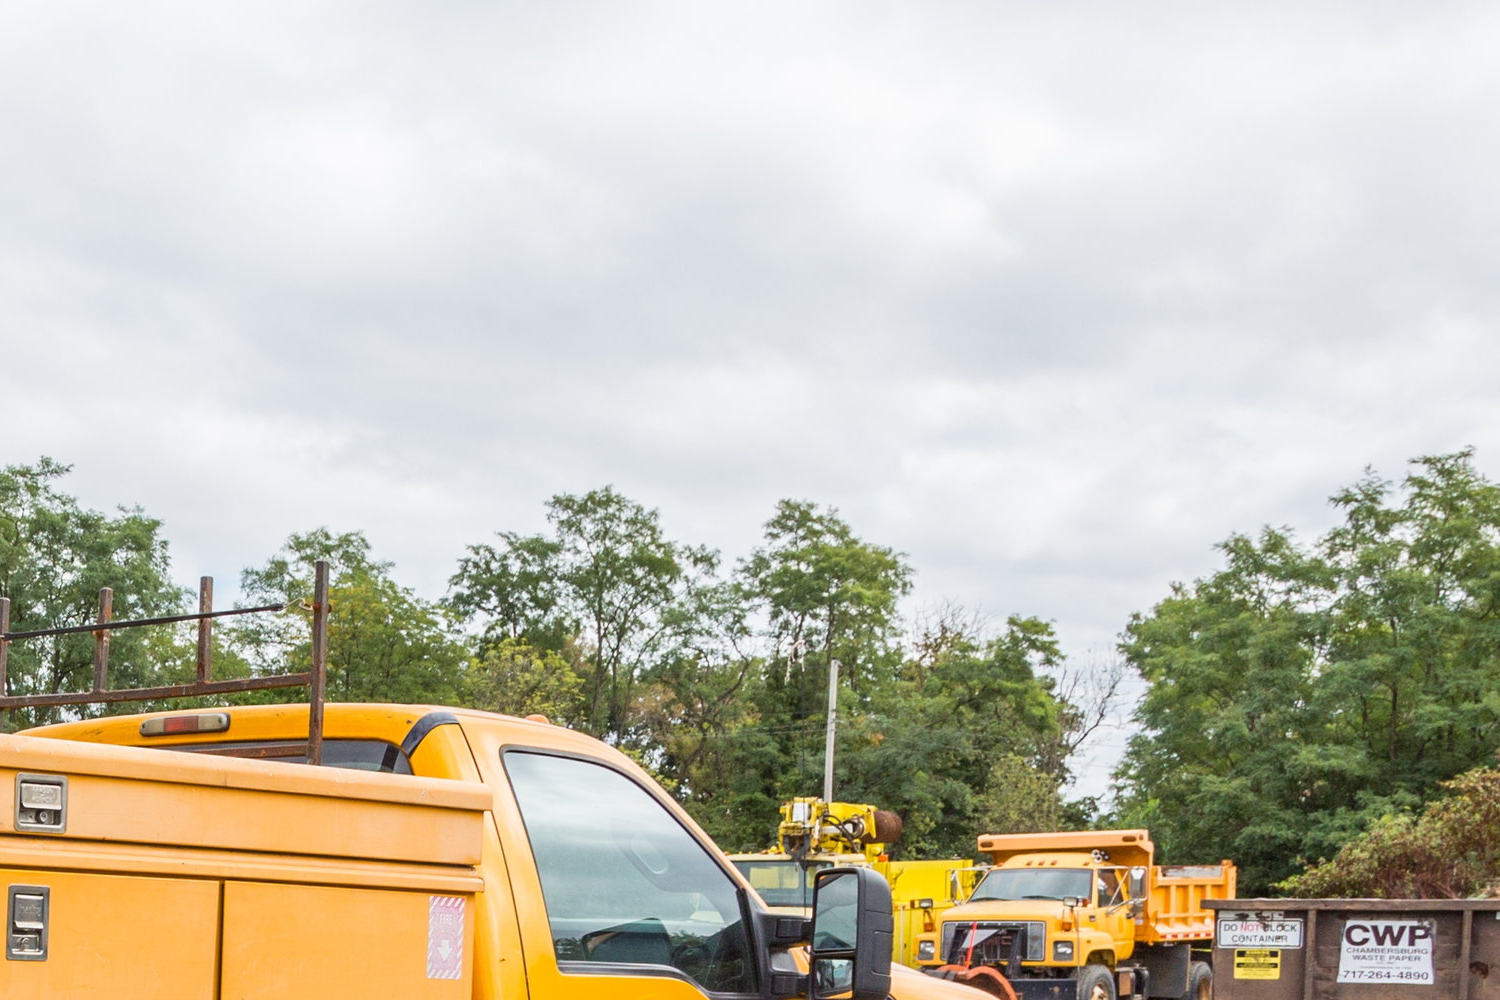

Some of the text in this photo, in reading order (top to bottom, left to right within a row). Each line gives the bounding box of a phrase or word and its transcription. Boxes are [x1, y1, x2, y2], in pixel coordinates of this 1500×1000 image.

[440, 913, 453, 926] FIRE
[1223, 923, 1238, 932] DO
[1240, 923, 1260, 932] NOT
[1231, 934, 1288, 943] CONTAINER
[1345, 924, 1430, 947] CWP
[1352, 954, 1421, 962] WASTE PAPER
[1343, 970, 1429, 980] 717-264-4890
